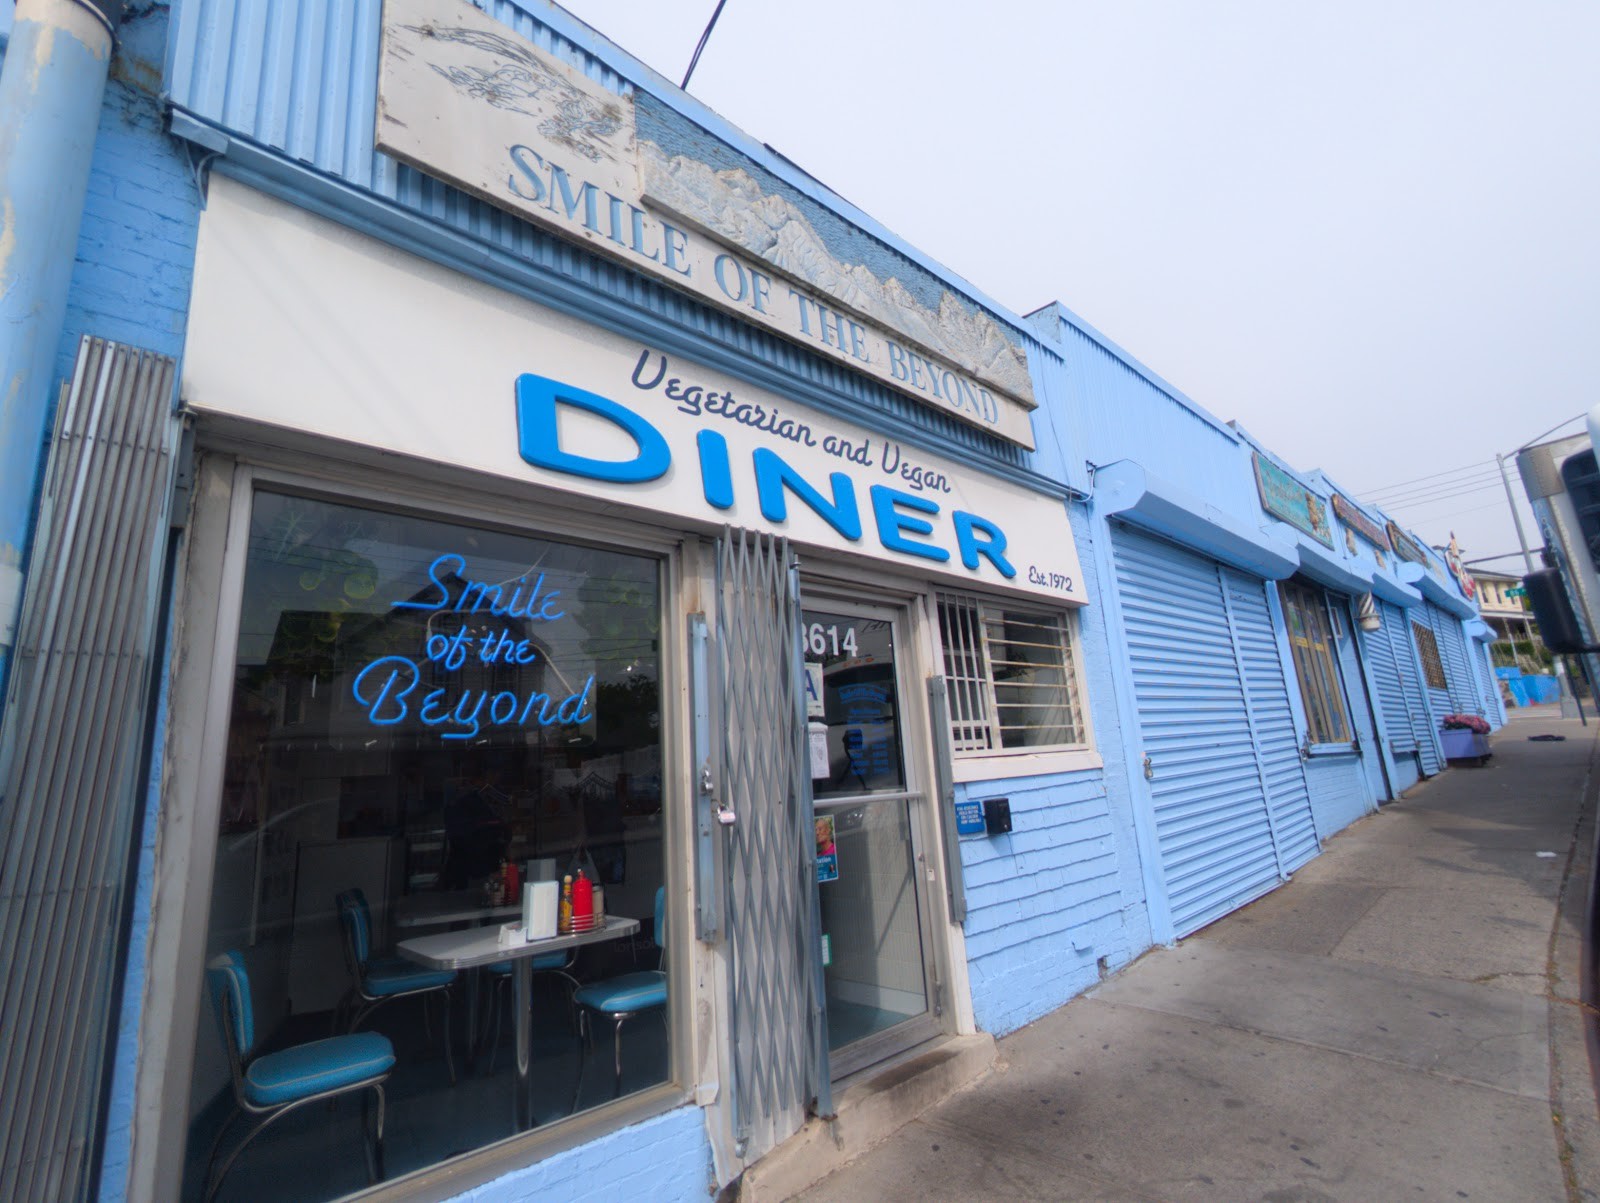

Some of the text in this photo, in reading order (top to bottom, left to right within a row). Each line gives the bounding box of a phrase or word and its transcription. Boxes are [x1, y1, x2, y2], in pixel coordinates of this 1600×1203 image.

[508, 144, 999, 426] SMILE OF THE BEYOND
[514, 372, 1018, 580] DINER
[631, 349, 951, 495] Vegetarian and Vegan
[390, 553, 567, 622] Smile
[352, 655, 596, 740] Beyond
[426, 625, 536, 672] of the
